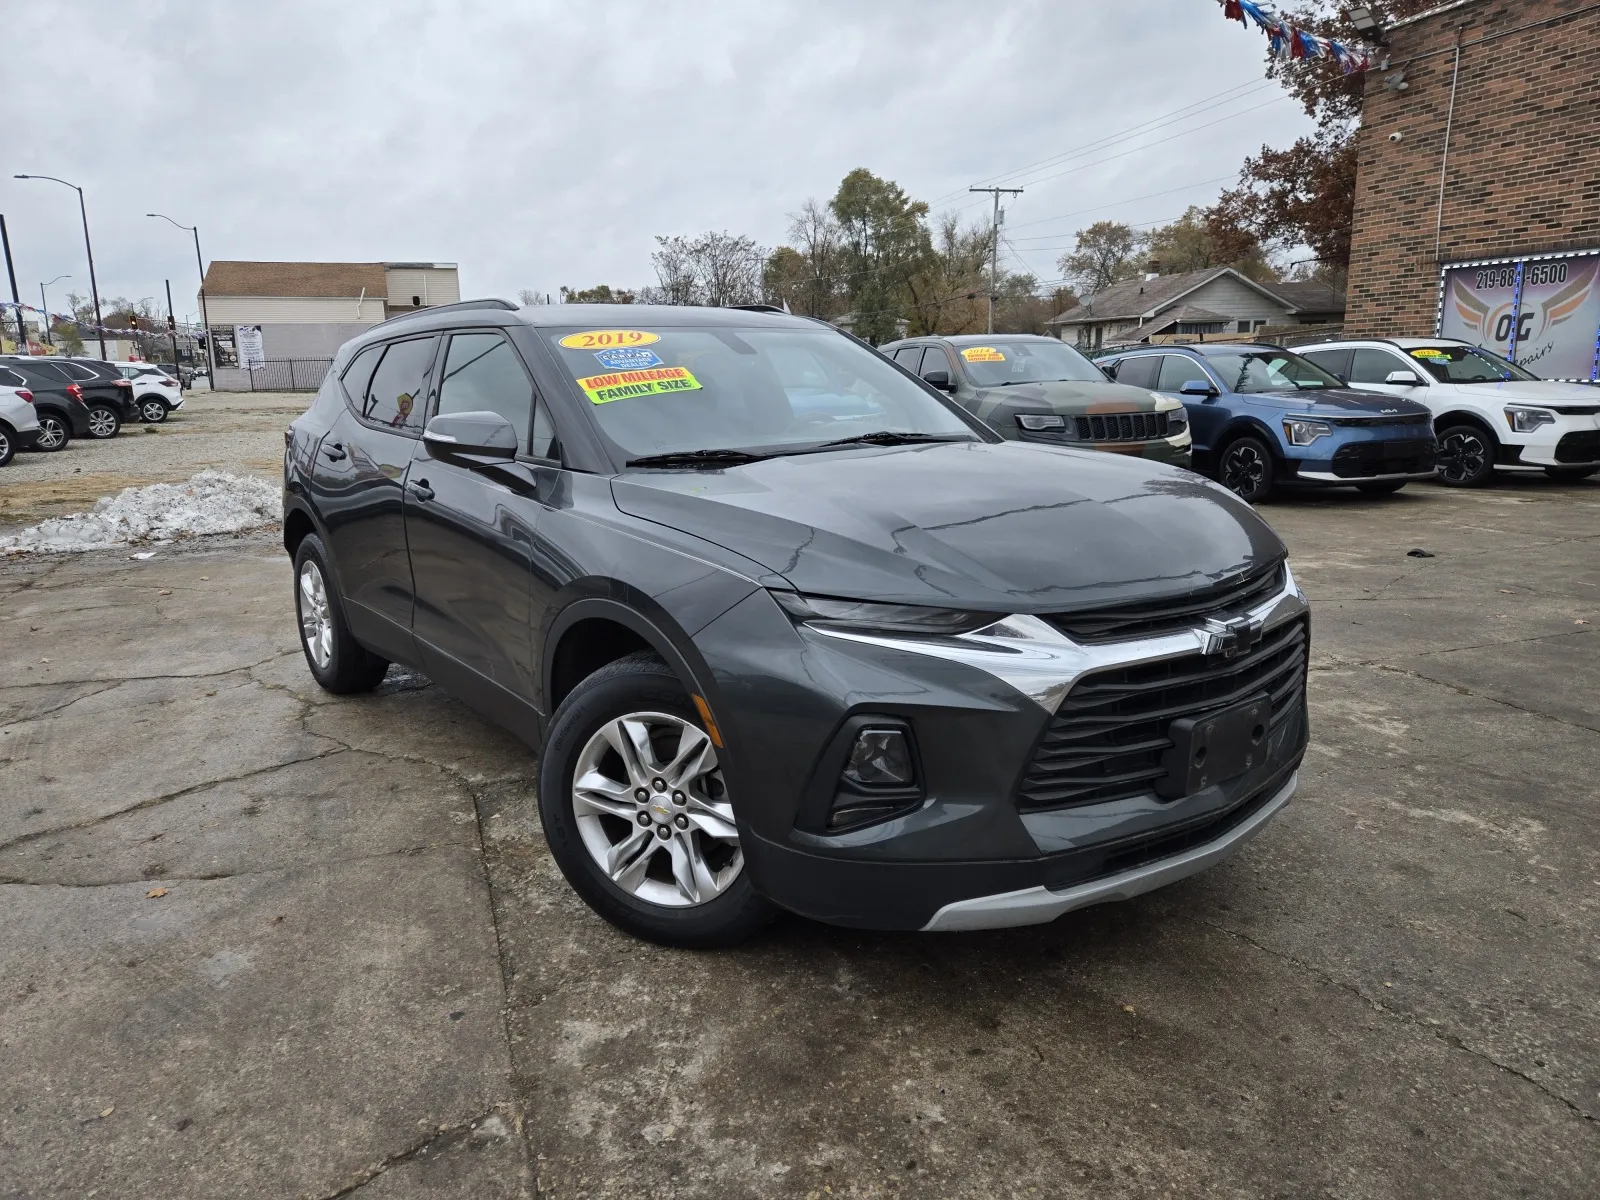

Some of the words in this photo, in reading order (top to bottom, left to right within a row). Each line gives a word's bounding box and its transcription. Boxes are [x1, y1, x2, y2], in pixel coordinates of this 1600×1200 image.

[1495, 312, 1535, 342] OG
[581, 332, 643, 347] 2019
[1514, 340, 1554, 367] epairs
[585, 375, 619, 389] LOW
[622, 368, 686, 383] MILEAGE
[596, 383, 654, 400] FAMILY
[657, 379, 691, 391] SIZE
